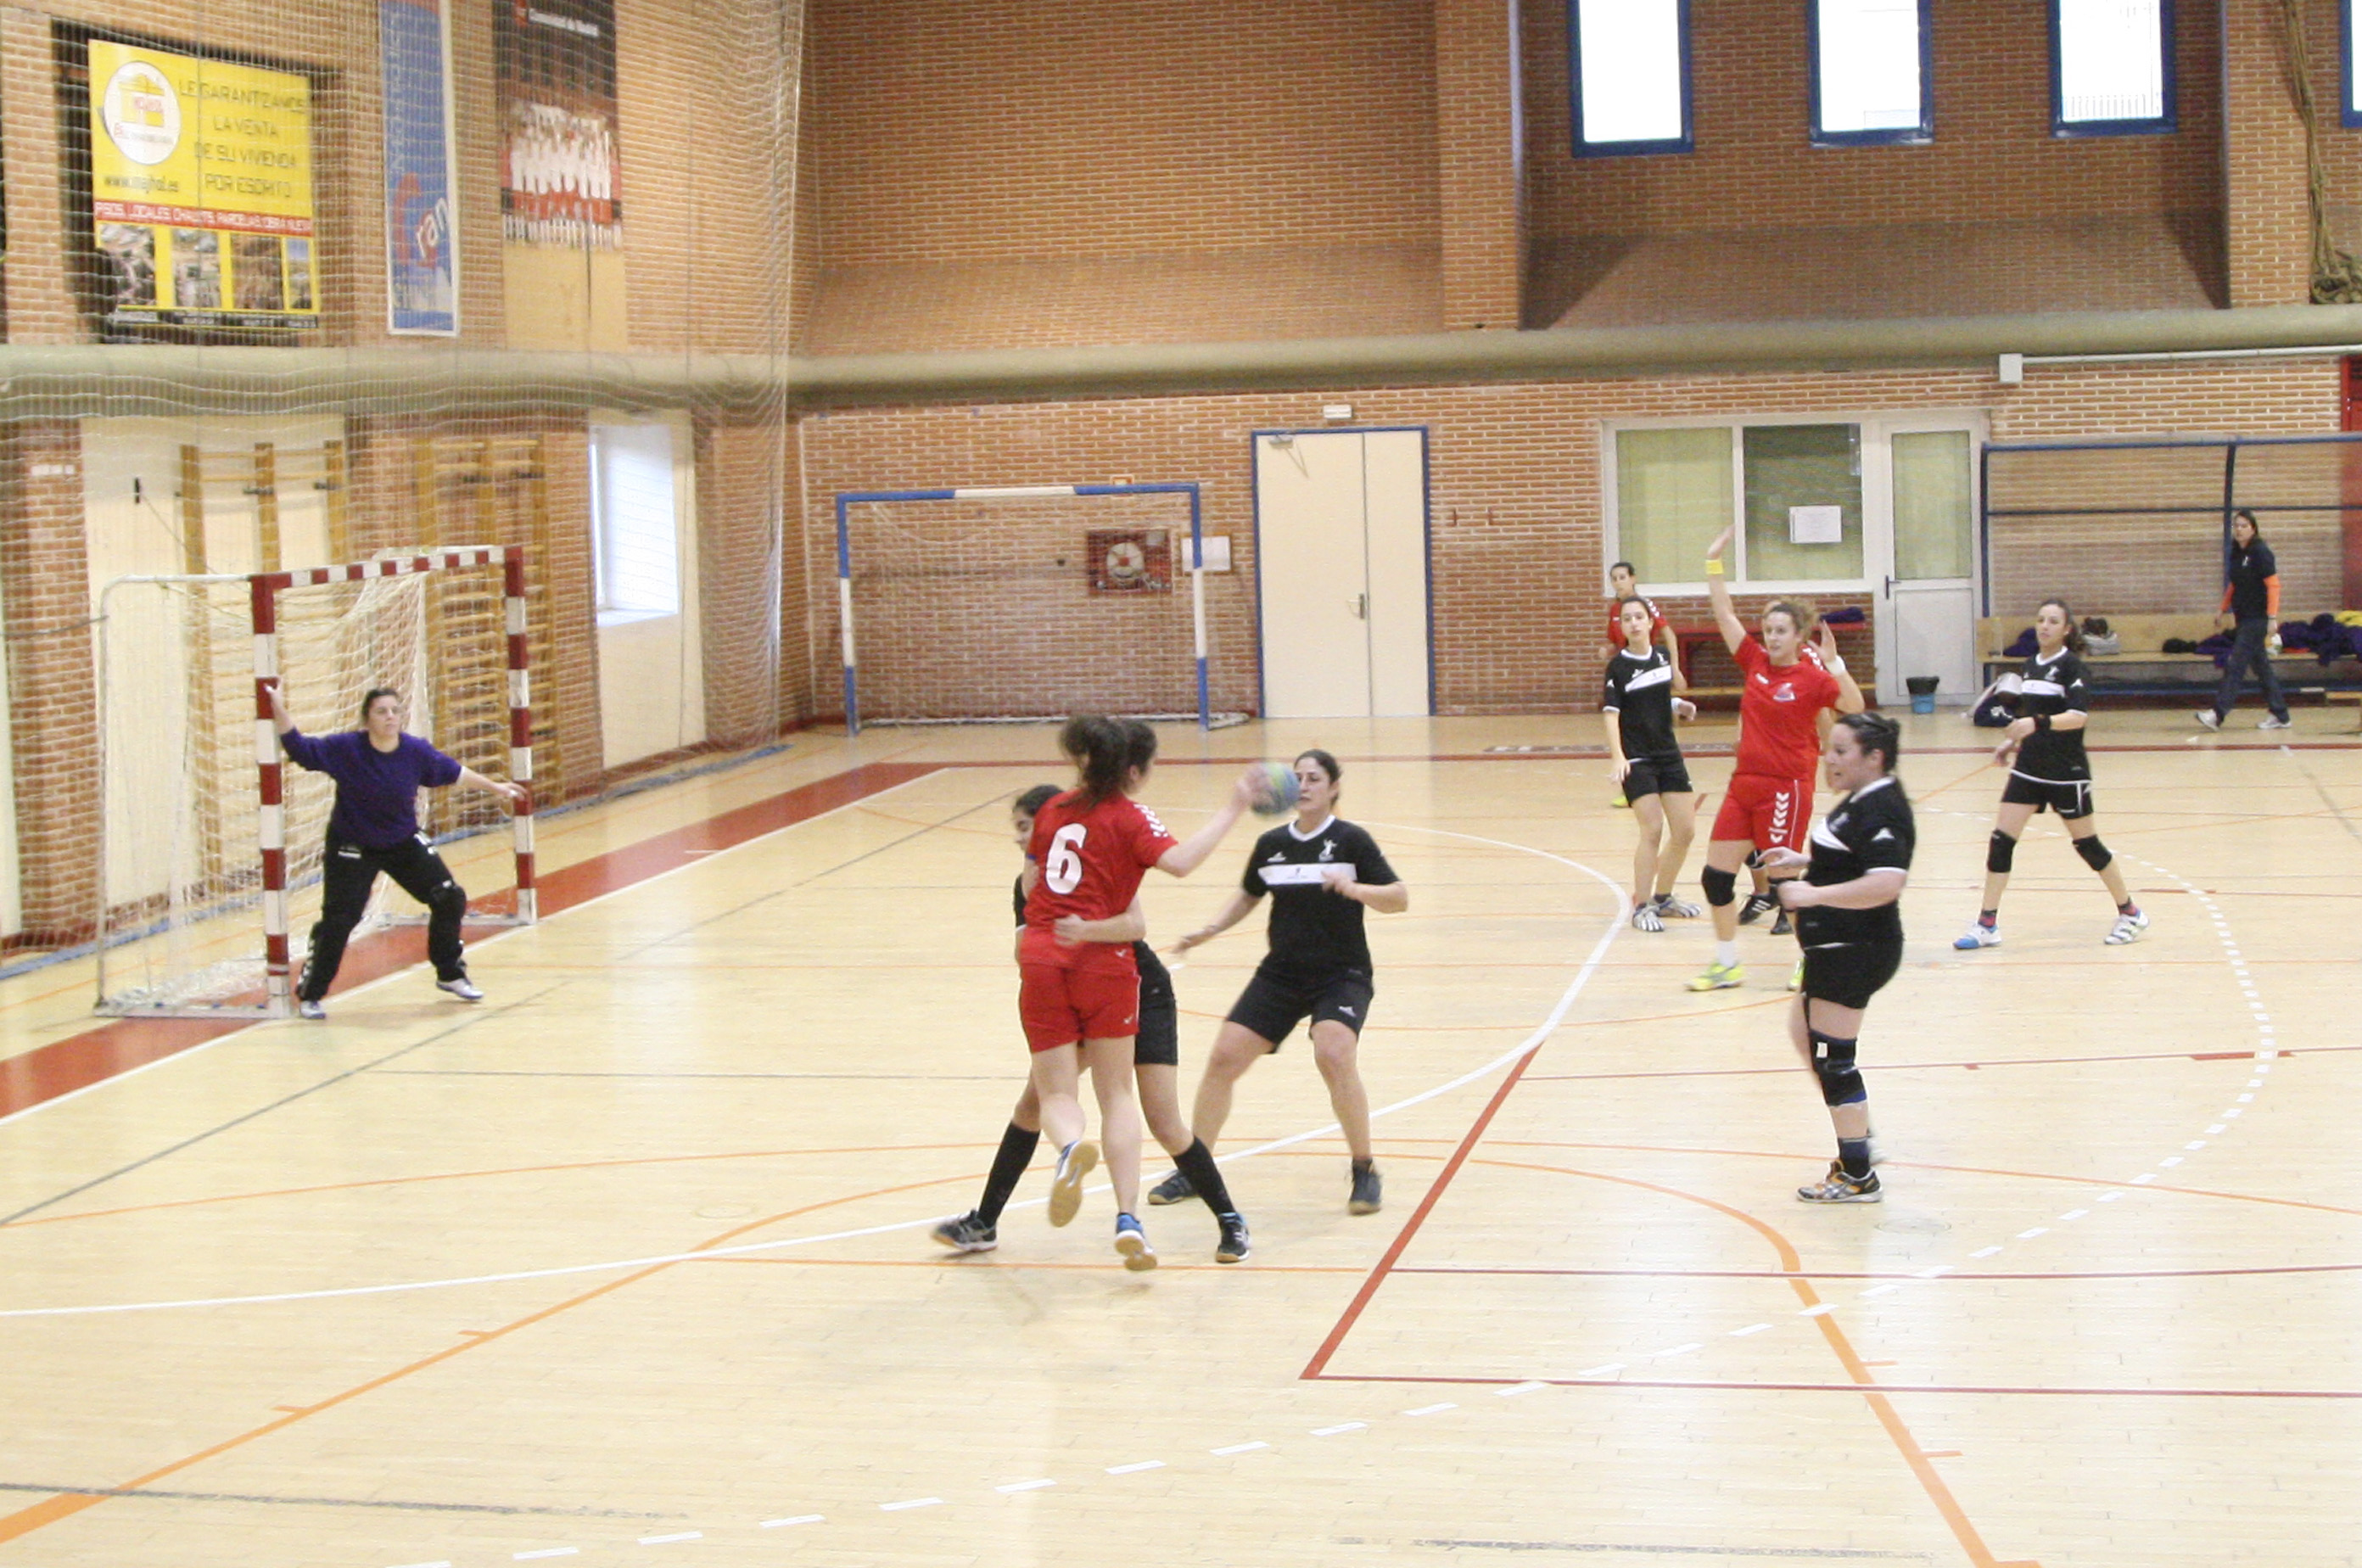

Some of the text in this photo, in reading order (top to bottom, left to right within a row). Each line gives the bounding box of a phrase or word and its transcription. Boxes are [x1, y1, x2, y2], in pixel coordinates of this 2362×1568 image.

[213, 115, 279, 137] LA VENTA
[194, 141, 214, 160] DE
[204, 172, 232, 191] POR
[1045, 822, 1087, 895] 6
